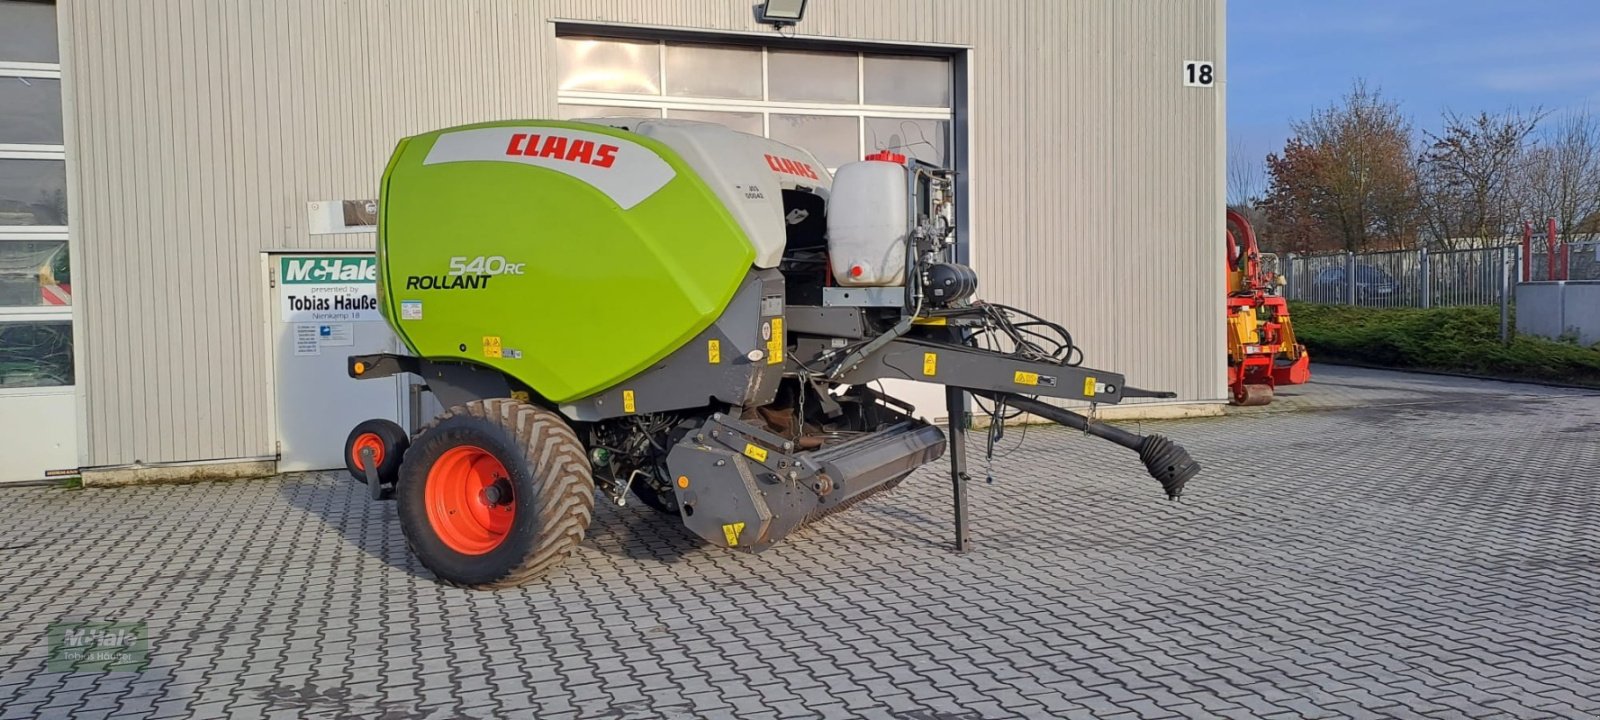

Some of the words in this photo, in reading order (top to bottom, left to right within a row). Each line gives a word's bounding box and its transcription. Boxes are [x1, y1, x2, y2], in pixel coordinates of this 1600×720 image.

[1186, 63, 1213, 85] 18
[505, 133, 620, 169] CLAAS
[764, 154, 818, 180] CLAAS
[285, 259, 377, 281] McHale
[406, 275, 492, 290] ROLLANT
[287, 295, 330, 311] Tobias
[334, 293, 377, 311] Häuße
[312, 312, 349, 320] Nienkamp
